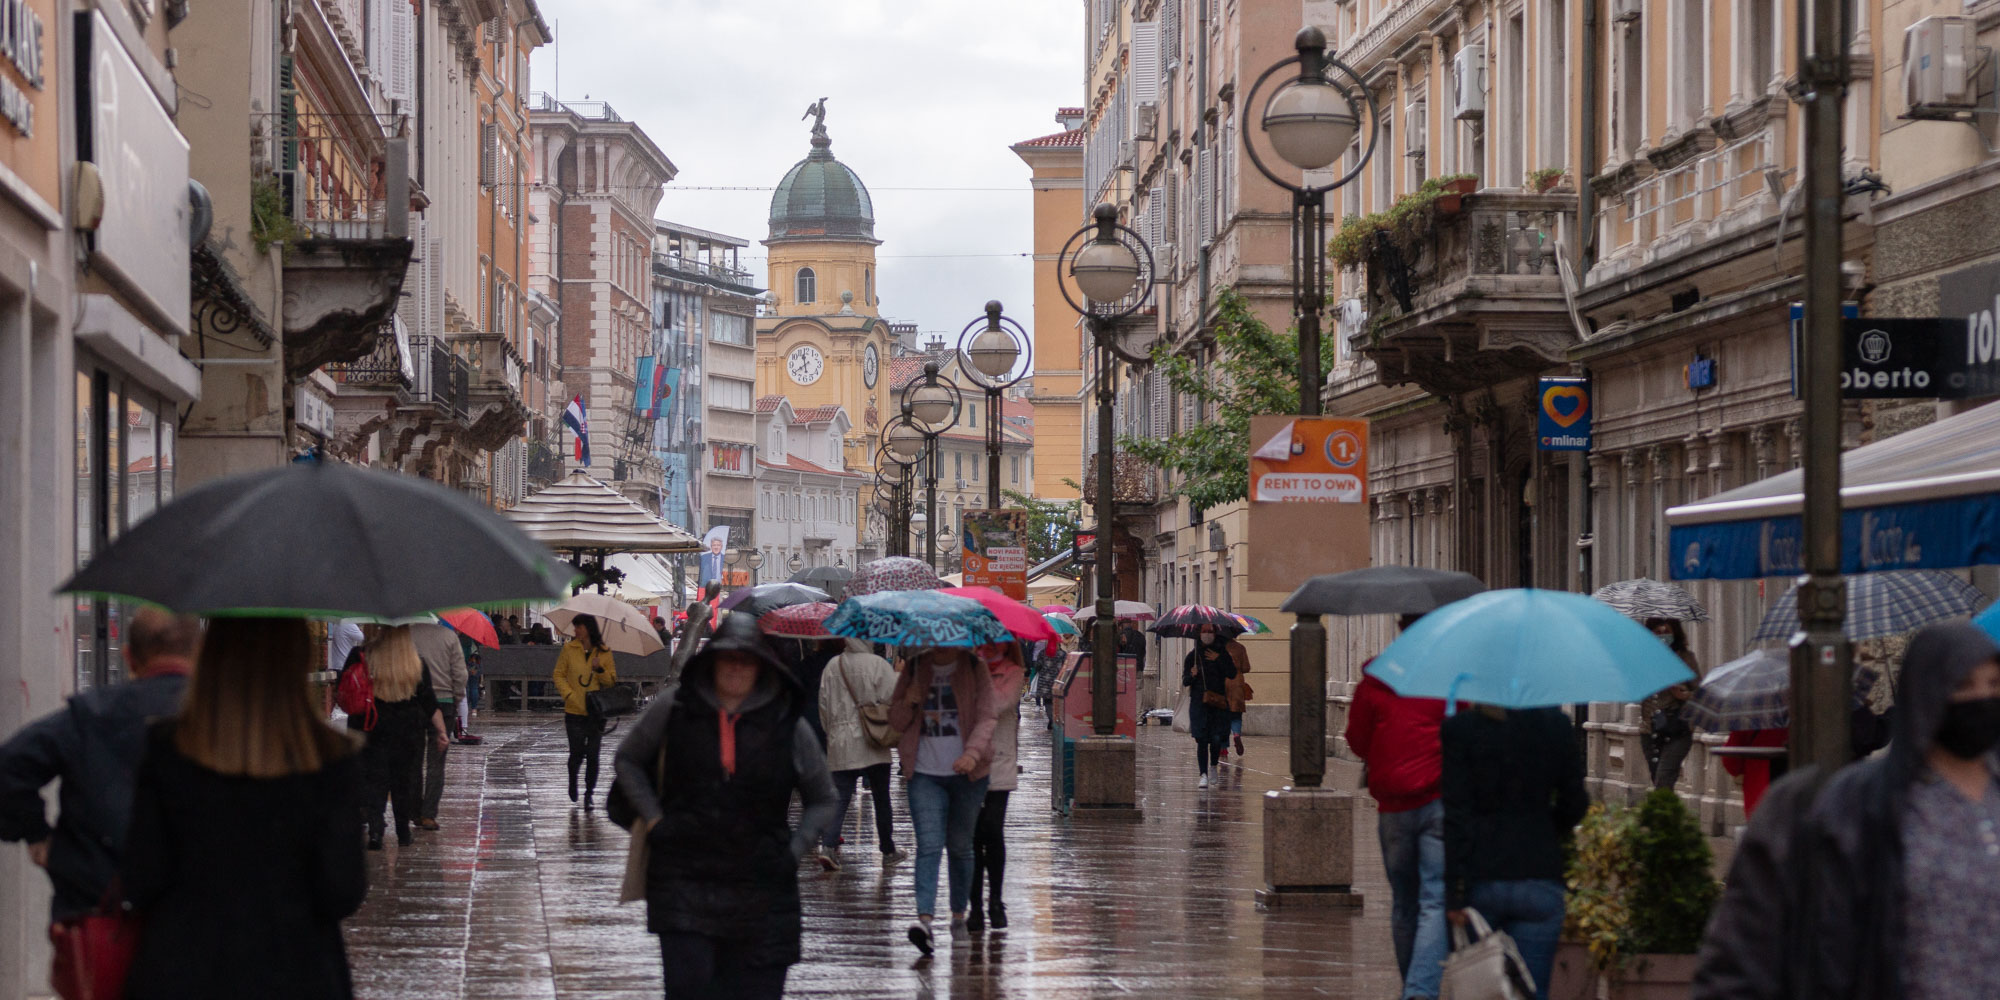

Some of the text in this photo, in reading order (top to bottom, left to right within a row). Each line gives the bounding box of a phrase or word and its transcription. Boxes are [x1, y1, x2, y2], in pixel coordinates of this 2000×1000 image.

[1840, 367, 1930, 388] oberto
[1552, 434, 1588, 446] mlinar
[1264, 478, 1356, 490] RENT TO OWN
